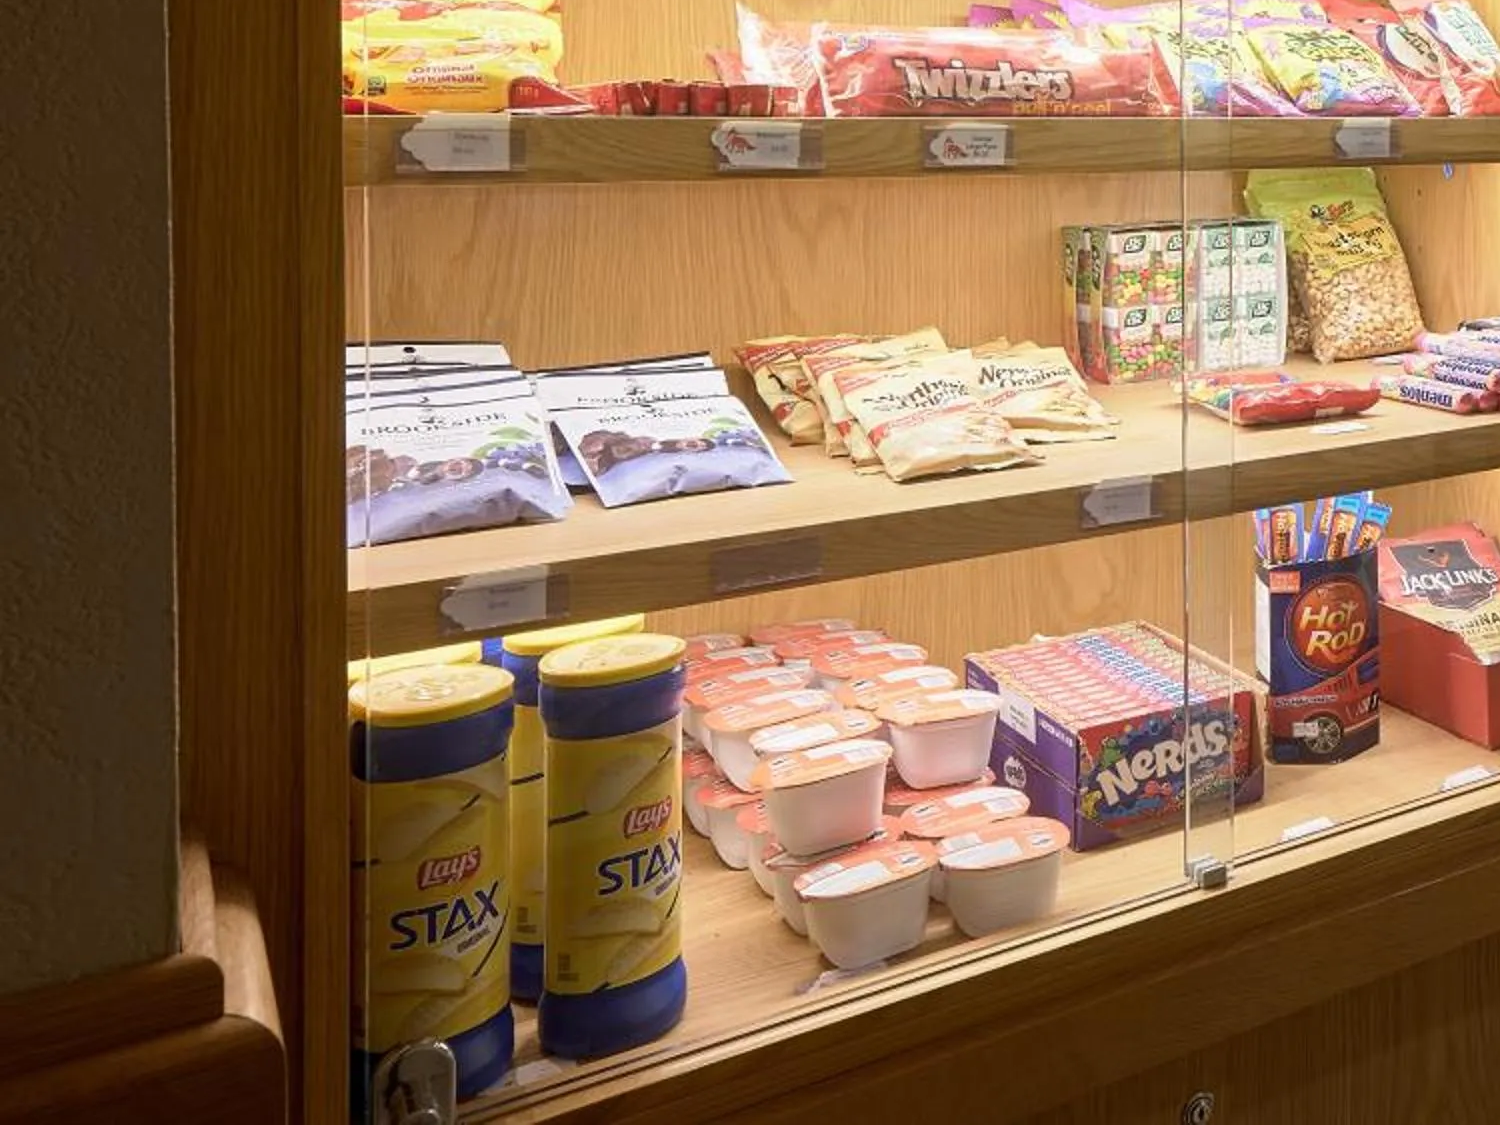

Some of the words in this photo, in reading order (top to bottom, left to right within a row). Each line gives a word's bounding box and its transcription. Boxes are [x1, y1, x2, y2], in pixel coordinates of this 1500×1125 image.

[894, 57, 1076, 107] Twizzlers
[1399, 384, 1453, 408] mentos
[1401, 569, 1444, 595] JACK
[598, 831, 680, 896] STAX
[390, 880, 499, 951] STAX
